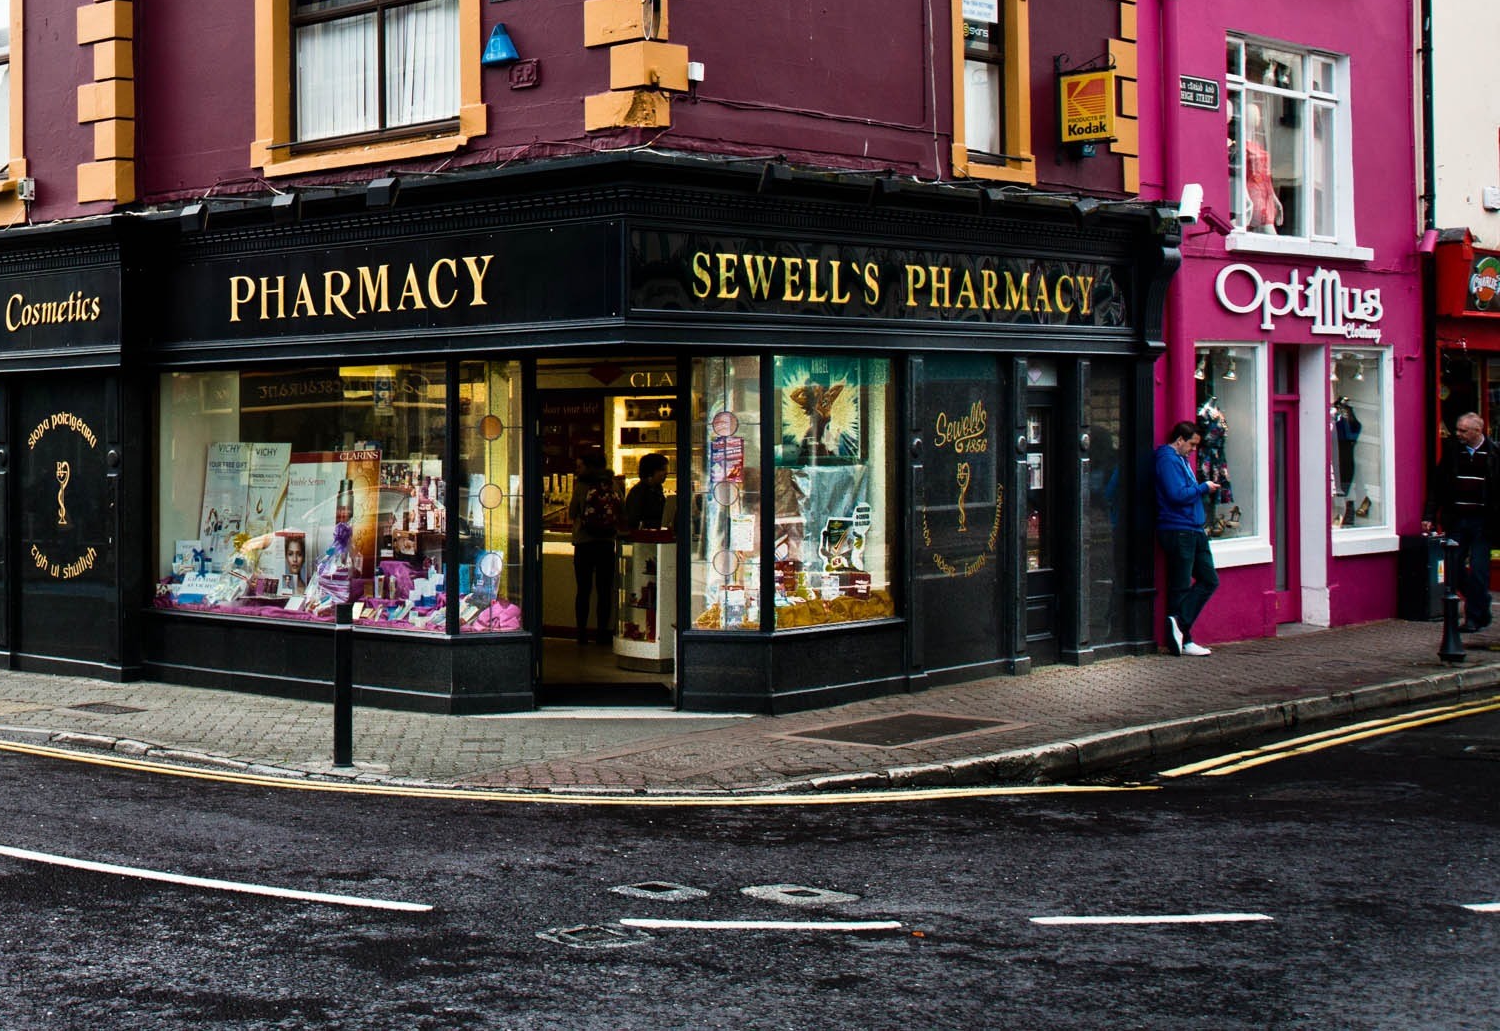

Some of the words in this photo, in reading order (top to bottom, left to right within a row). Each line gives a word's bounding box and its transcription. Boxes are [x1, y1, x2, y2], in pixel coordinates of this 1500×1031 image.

[1196, 93, 1214, 104] STREET
[1068, 116, 1097, 124] PRODUCTS
[1068, 122, 1107, 136] Kodak
[229, 255, 494, 322] PHARMACY
[905, 264, 1093, 315] PHARMACY
[6, 290, 101, 333] Cosmetics
[1344, 322, 1382, 344] Clothing
[219, 443, 241, 453] VICHY
[256, 448, 278, 457] VICHY
[965, 438, 987, 453] 1856
[340, 451, 378, 460] CLARINS
